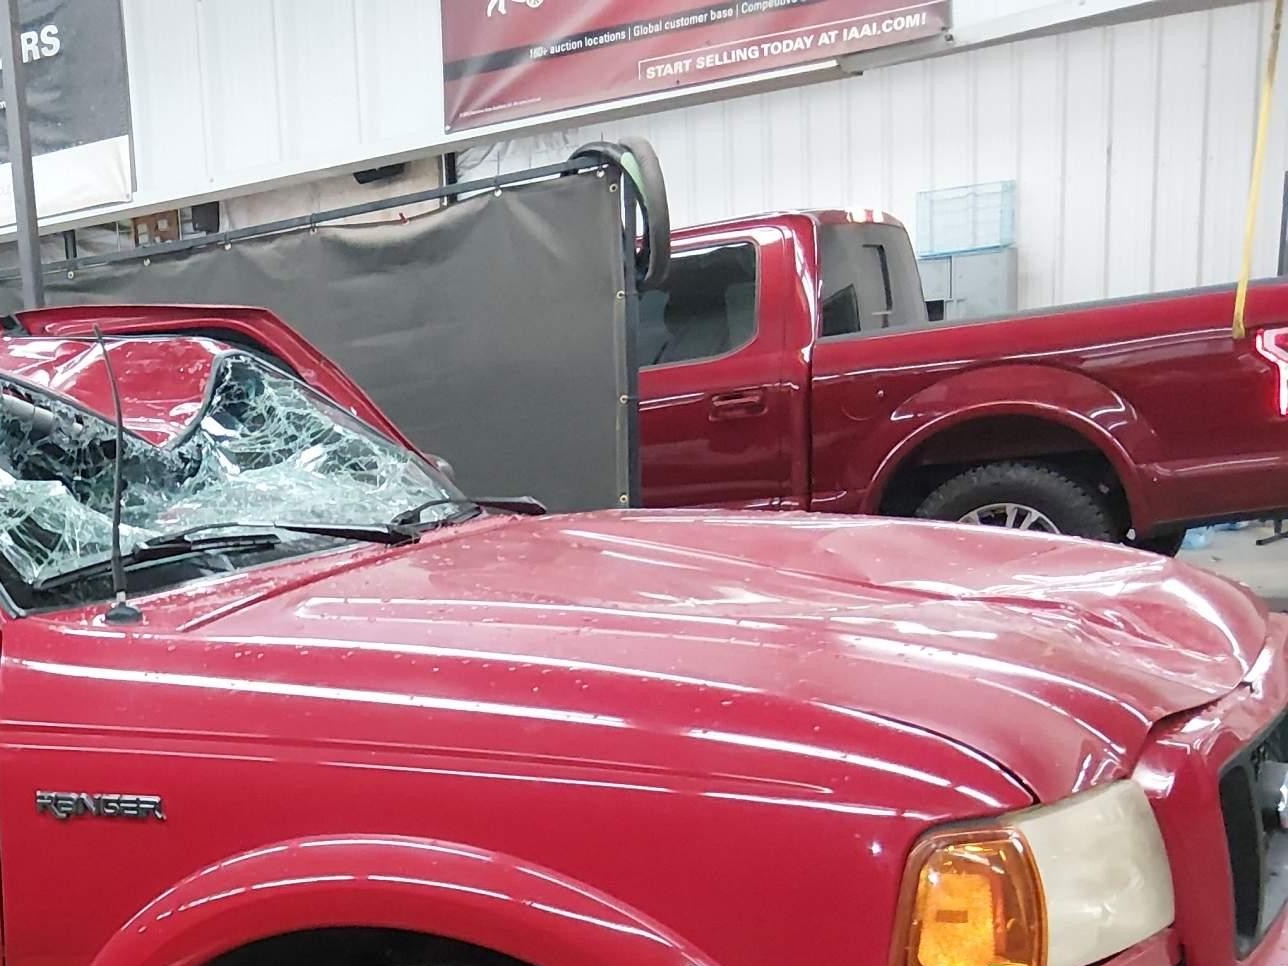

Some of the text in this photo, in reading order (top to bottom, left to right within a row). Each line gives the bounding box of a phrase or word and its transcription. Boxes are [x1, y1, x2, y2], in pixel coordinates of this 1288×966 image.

[550, 39, 583, 55] auction
[584, 30, 626, 47] locations
[633, 20, 662, 37] Global
[664, 12, 708, 30] customer
[710, 8, 733, 21] base
[646, 12, 927, 79] START SELLING TODAY AT IAAI.COM!
[35, 790, 168, 821] RANGER
